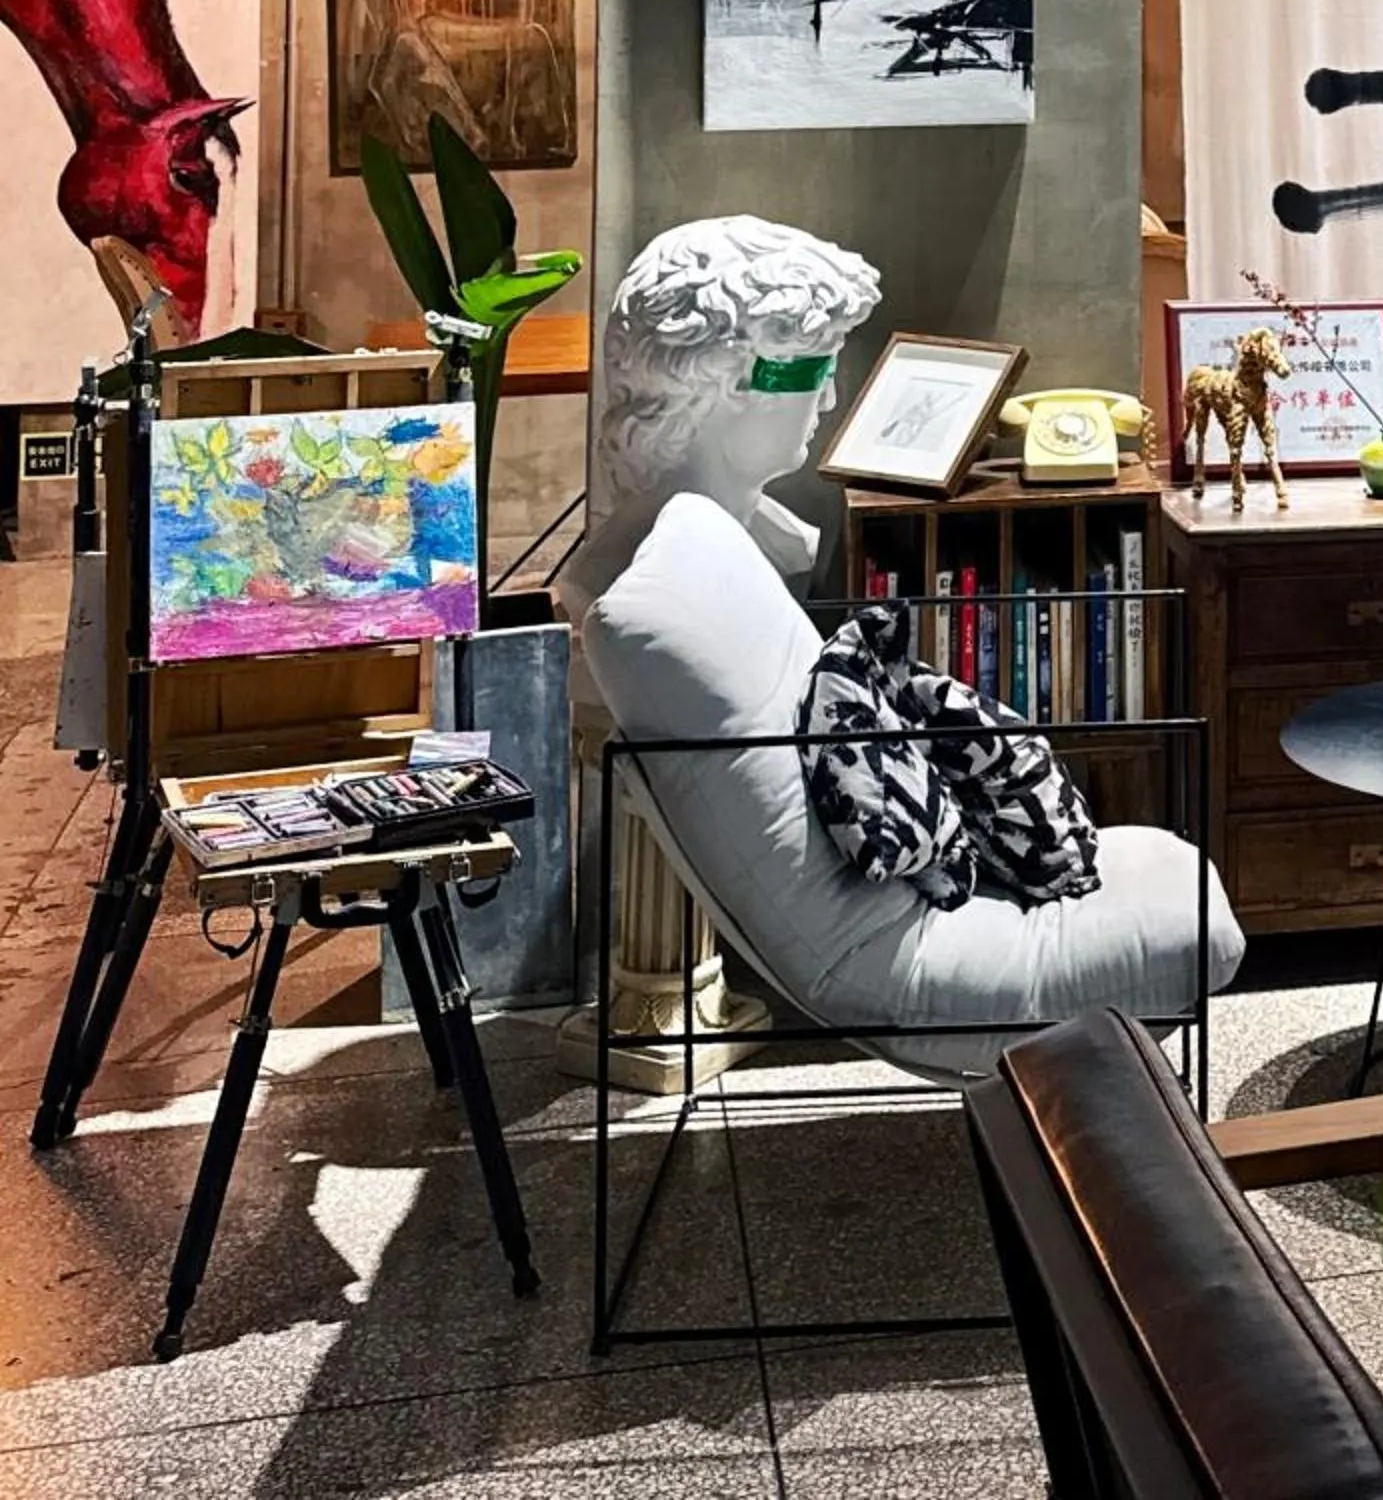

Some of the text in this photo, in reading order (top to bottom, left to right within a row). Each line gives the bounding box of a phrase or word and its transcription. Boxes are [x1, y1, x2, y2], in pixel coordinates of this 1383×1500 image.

[1270, 388, 1356, 412] 合作单位
[29, 457, 61, 469] EXIT
